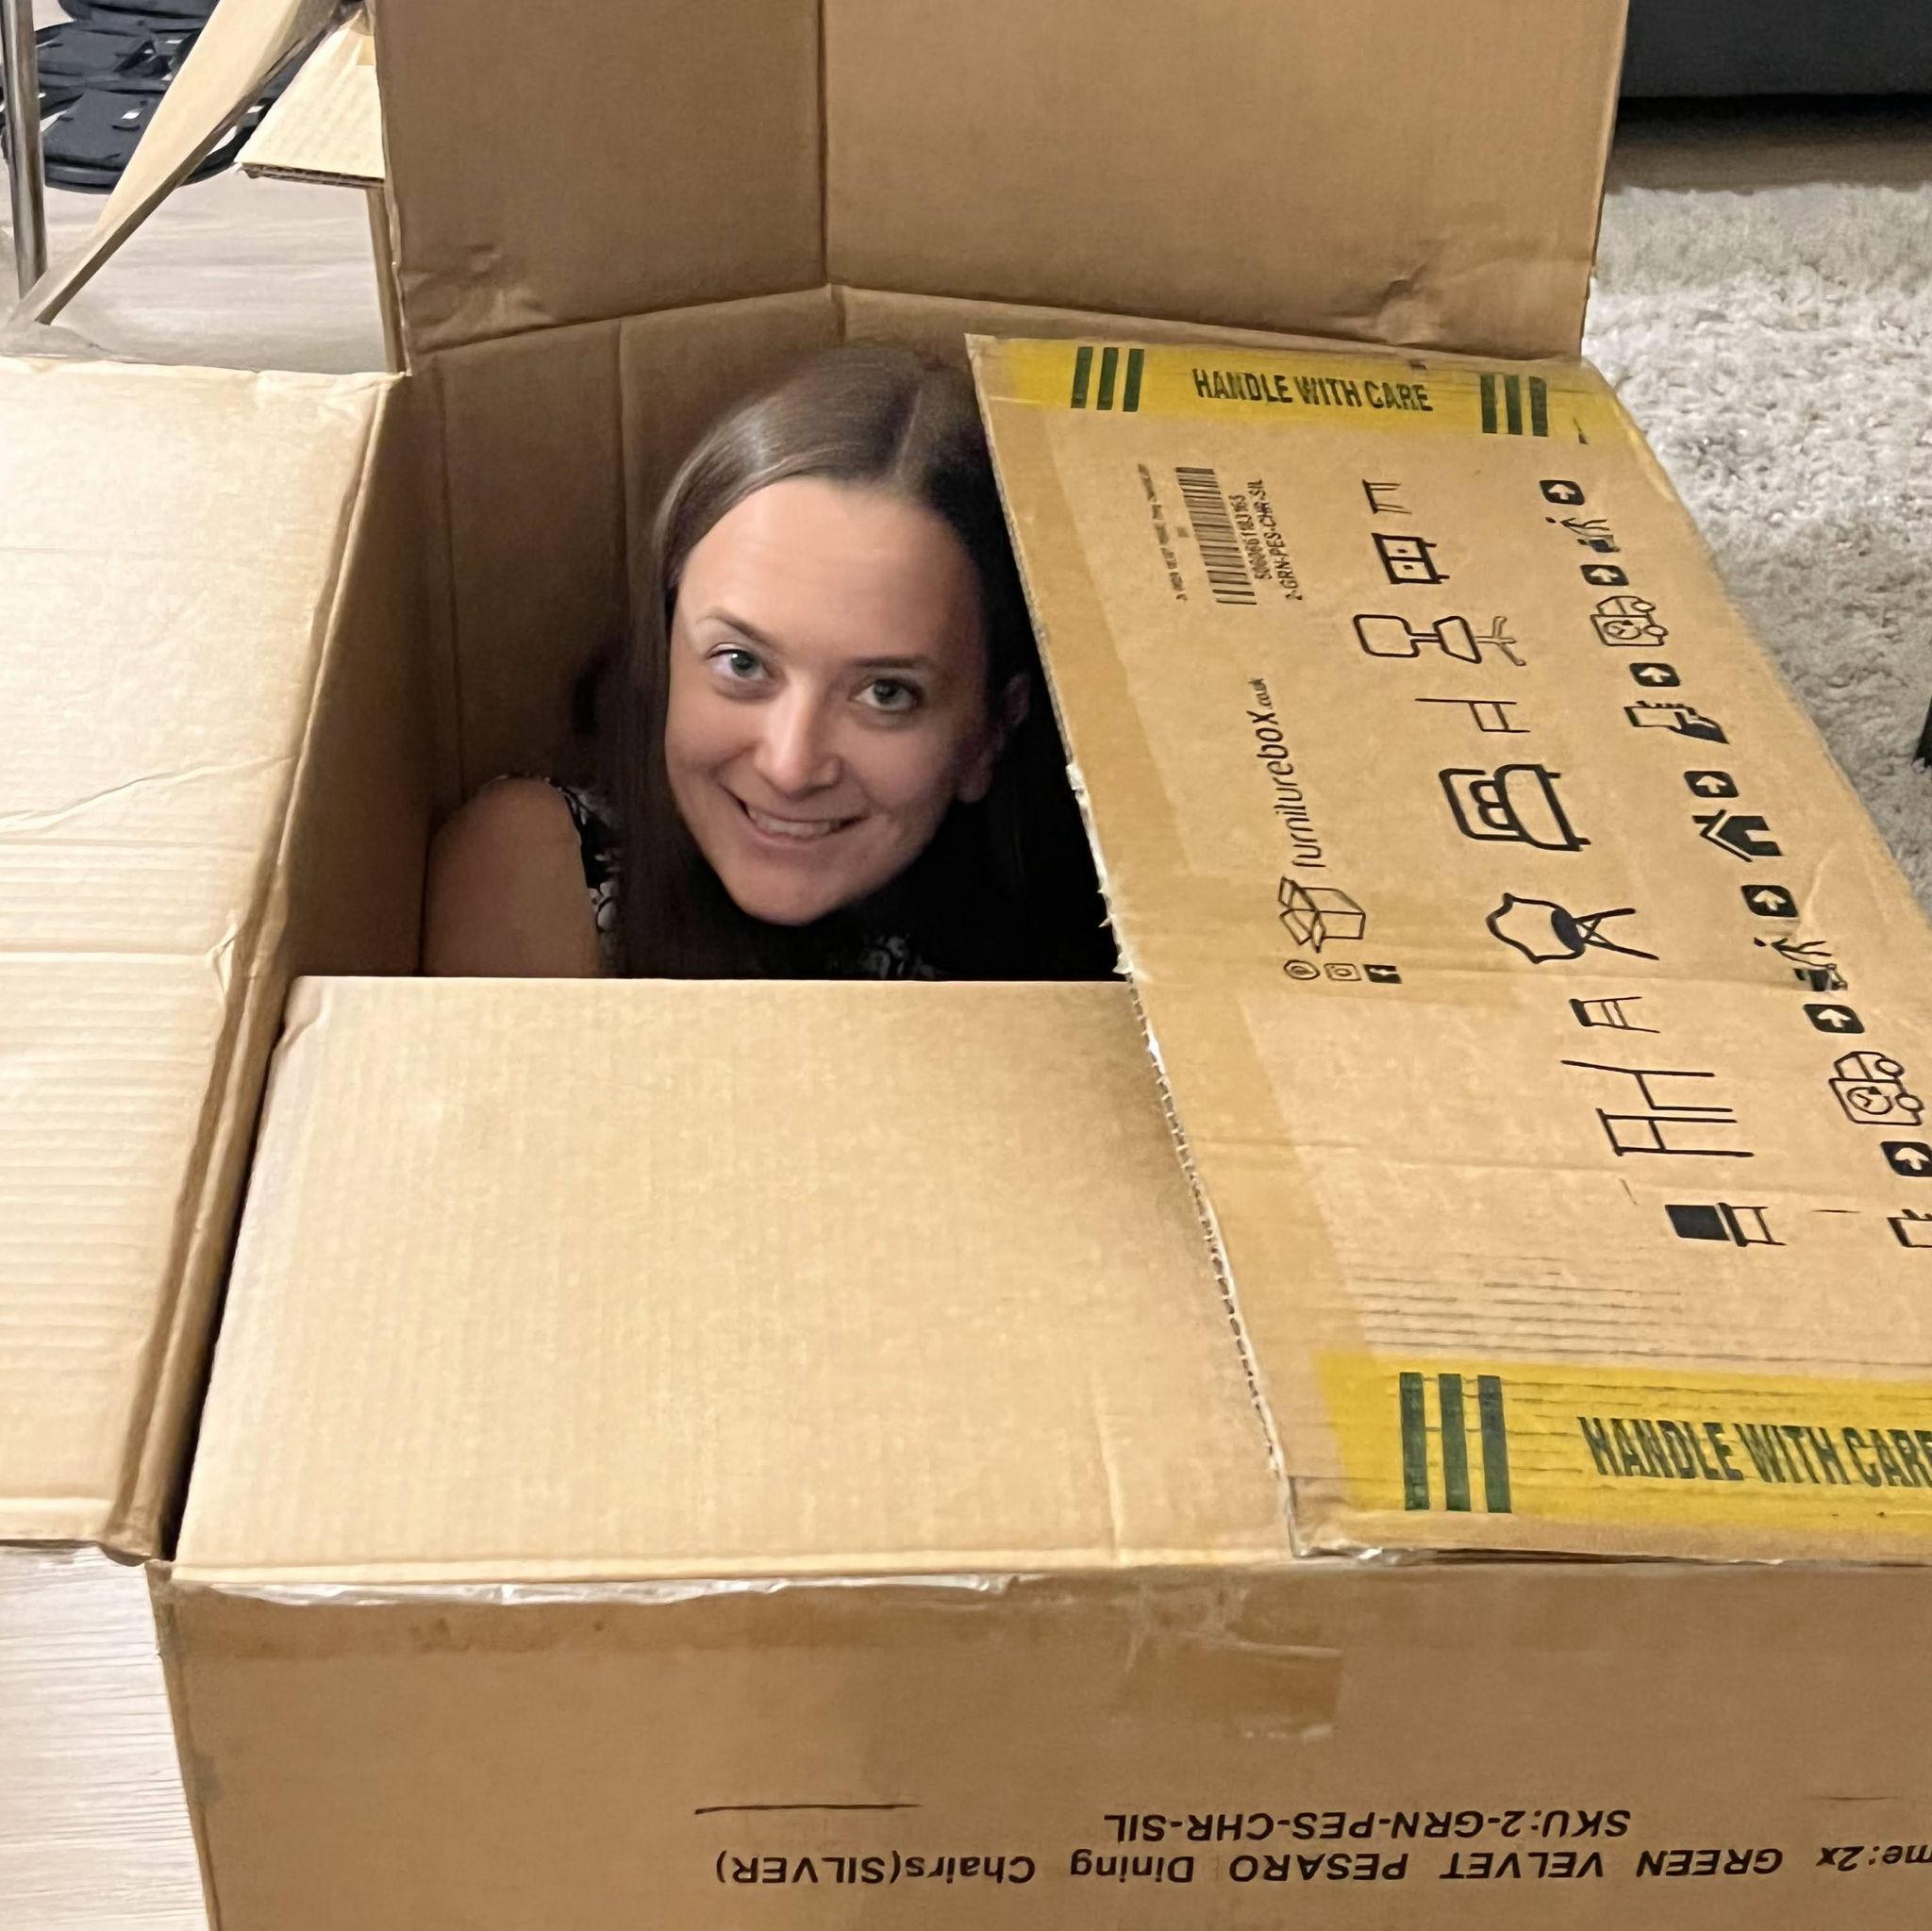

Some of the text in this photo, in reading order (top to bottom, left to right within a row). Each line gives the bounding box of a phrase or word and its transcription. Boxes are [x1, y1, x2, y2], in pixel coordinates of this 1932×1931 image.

[1191, 368, 1434, 411] HANDLE WITH CARE
[1579, 1416, 1744, 1481] HANDLE
[1731, 1423, 1850, 1486] WITH
[1105, 1810, 1631, 1842] SKU:2-GRN-PES-CHR-SIL
[716, 1850, 1036, 1885] Chairs(SILVER)
[1071, 1848, 1194, 1884] Dining
[1229, 1853, 1408, 1883] PESARO
[1440, 1851, 1604, 1880] VELVET
[1637, 1848, 1783, 1878] GREEN
